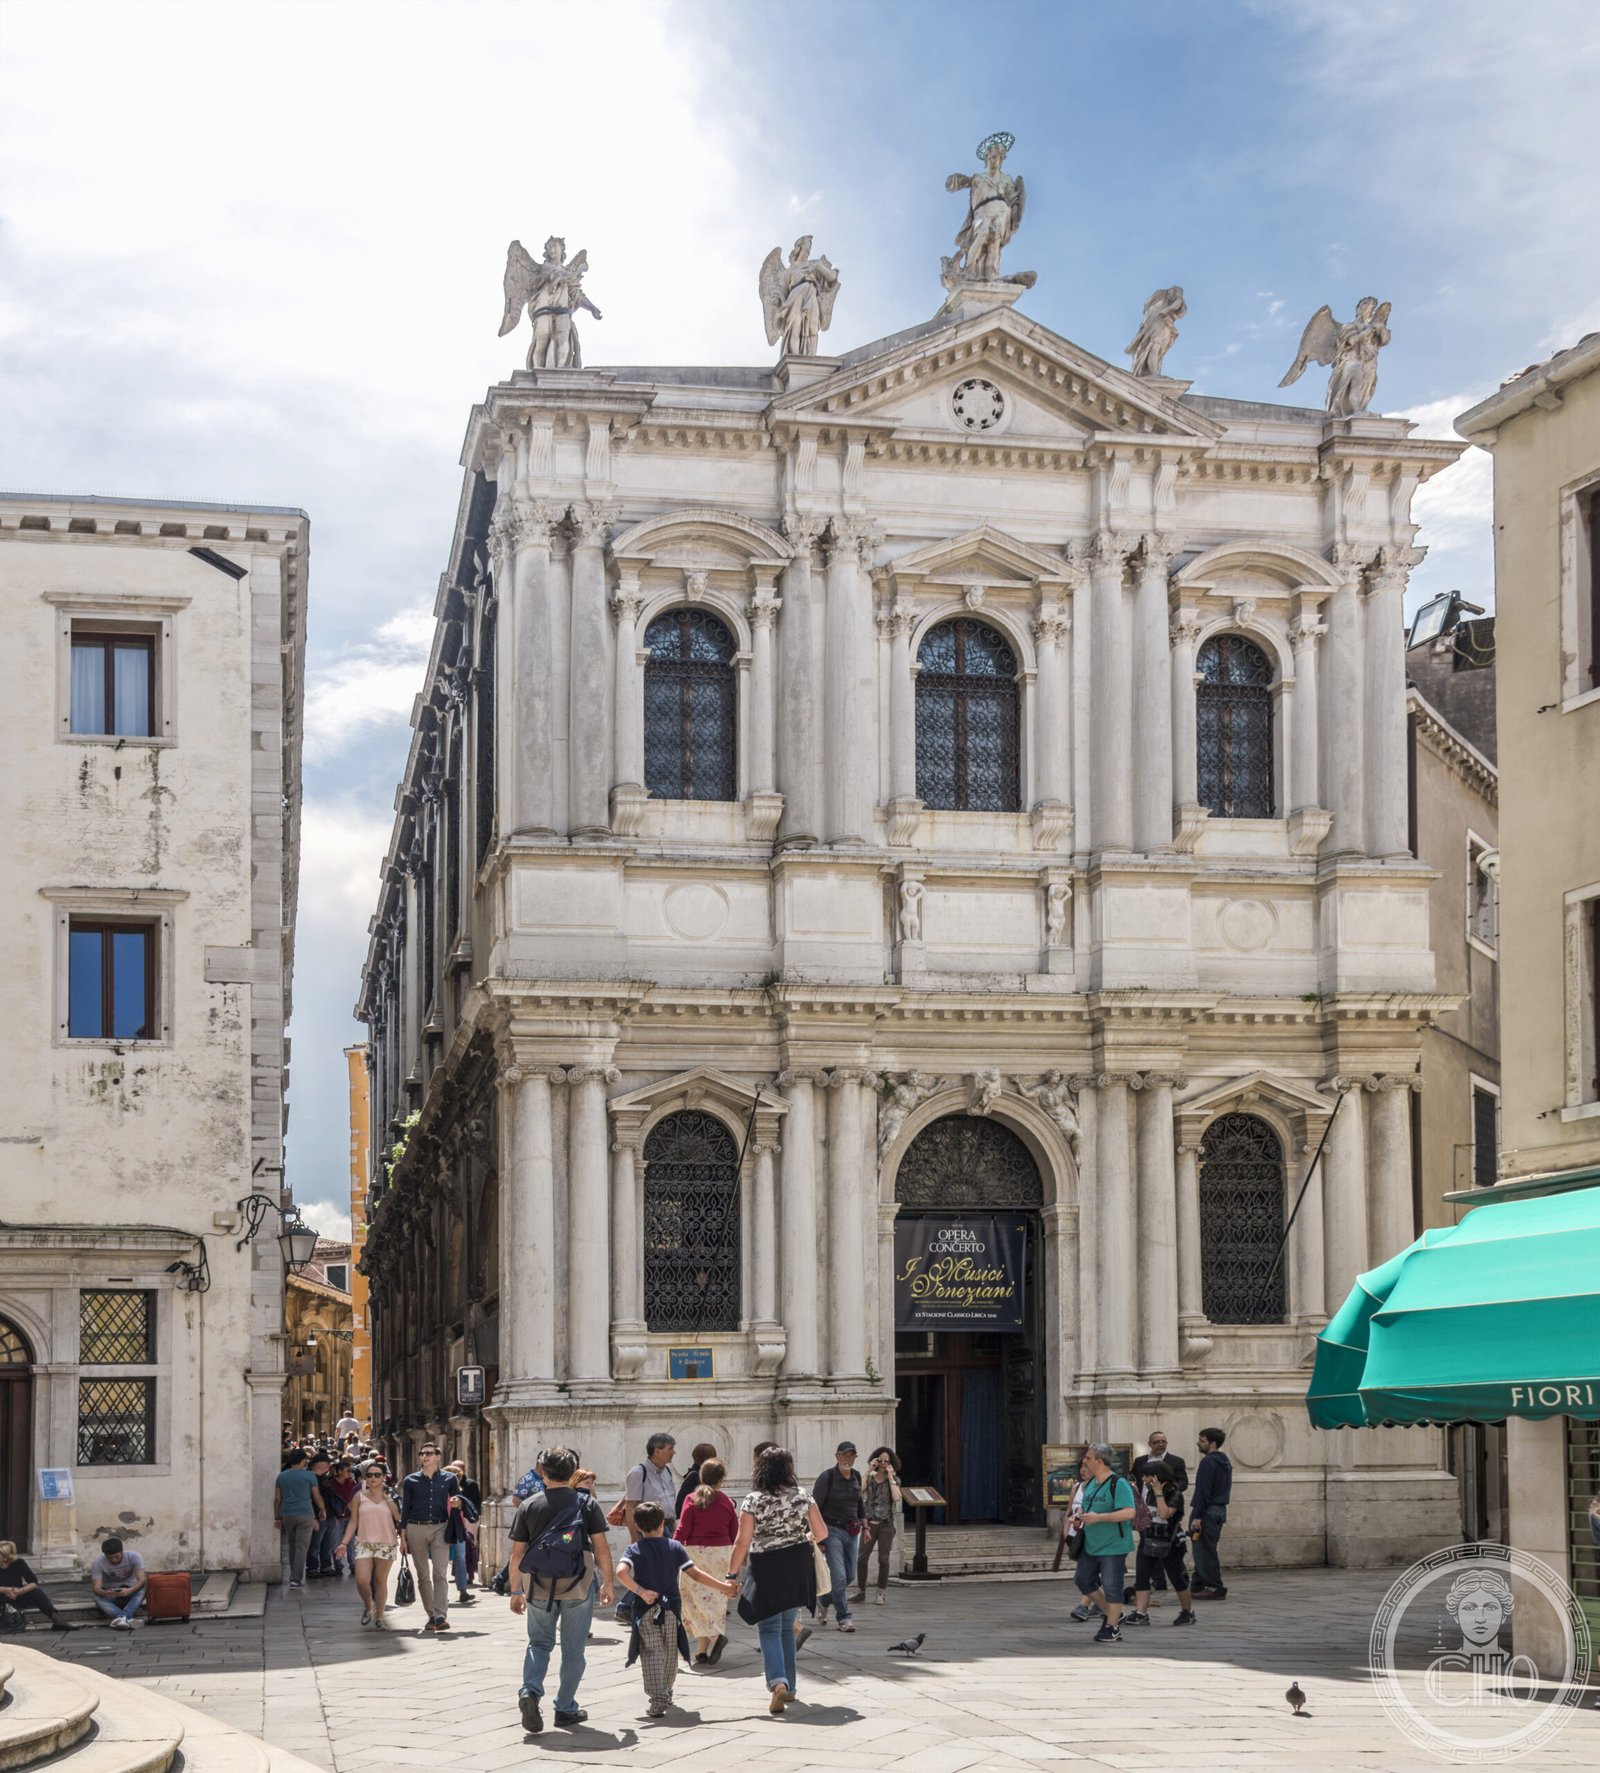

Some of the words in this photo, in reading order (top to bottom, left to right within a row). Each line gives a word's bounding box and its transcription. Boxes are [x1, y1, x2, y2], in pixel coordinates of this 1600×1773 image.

[938, 1229, 976, 1241] OPERA
[929, 1242, 985, 1253] CONCERTO
[928, 1256, 1005, 1281] Musici
[910, 1274, 1015, 1308] Veneziani
[462, 1369, 481, 1392] T
[1511, 1384, 1593, 1407] FIORI
